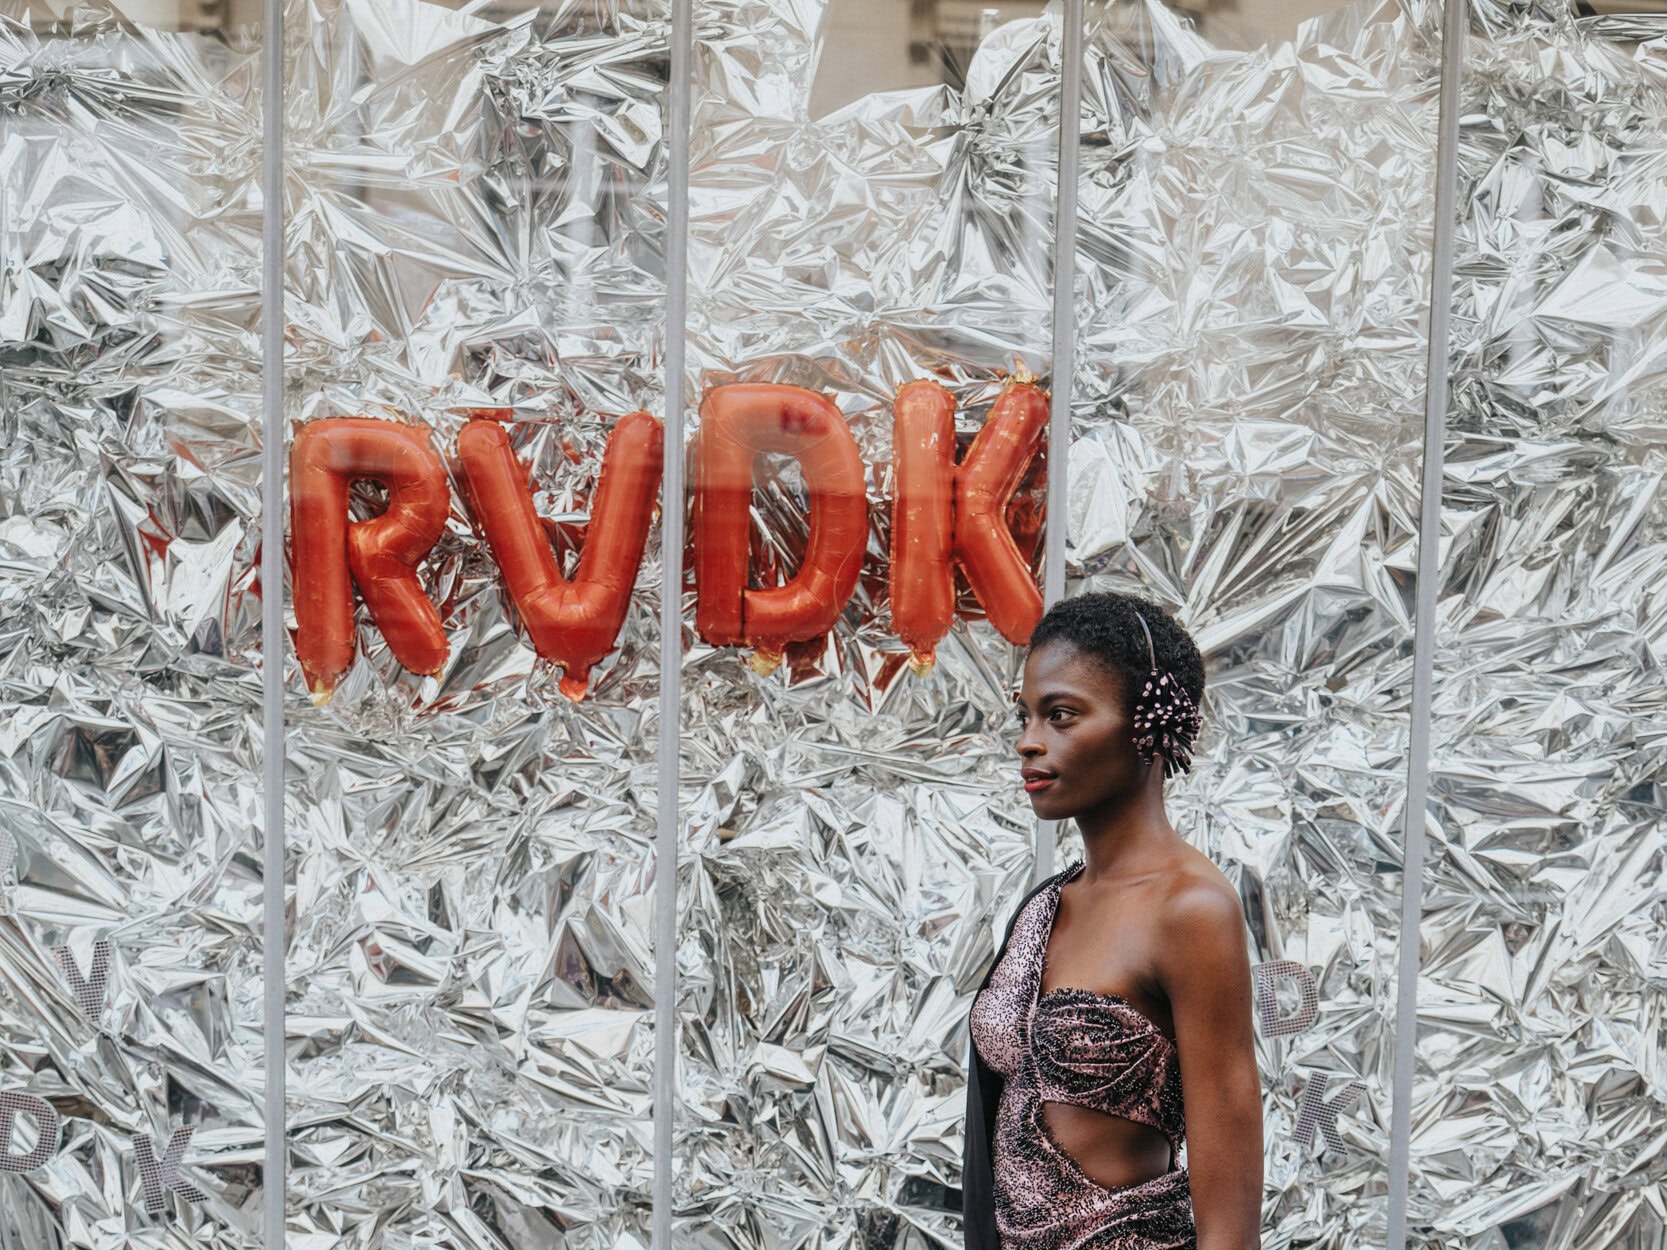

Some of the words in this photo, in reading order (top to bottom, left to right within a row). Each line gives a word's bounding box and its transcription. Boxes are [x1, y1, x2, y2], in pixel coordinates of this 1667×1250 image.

[289, 378, 1050, 694] RVDK
[1253, 959, 1319, 1039] D
[1292, 1070, 1368, 1155] K
[132, 1125, 210, 1216] K
